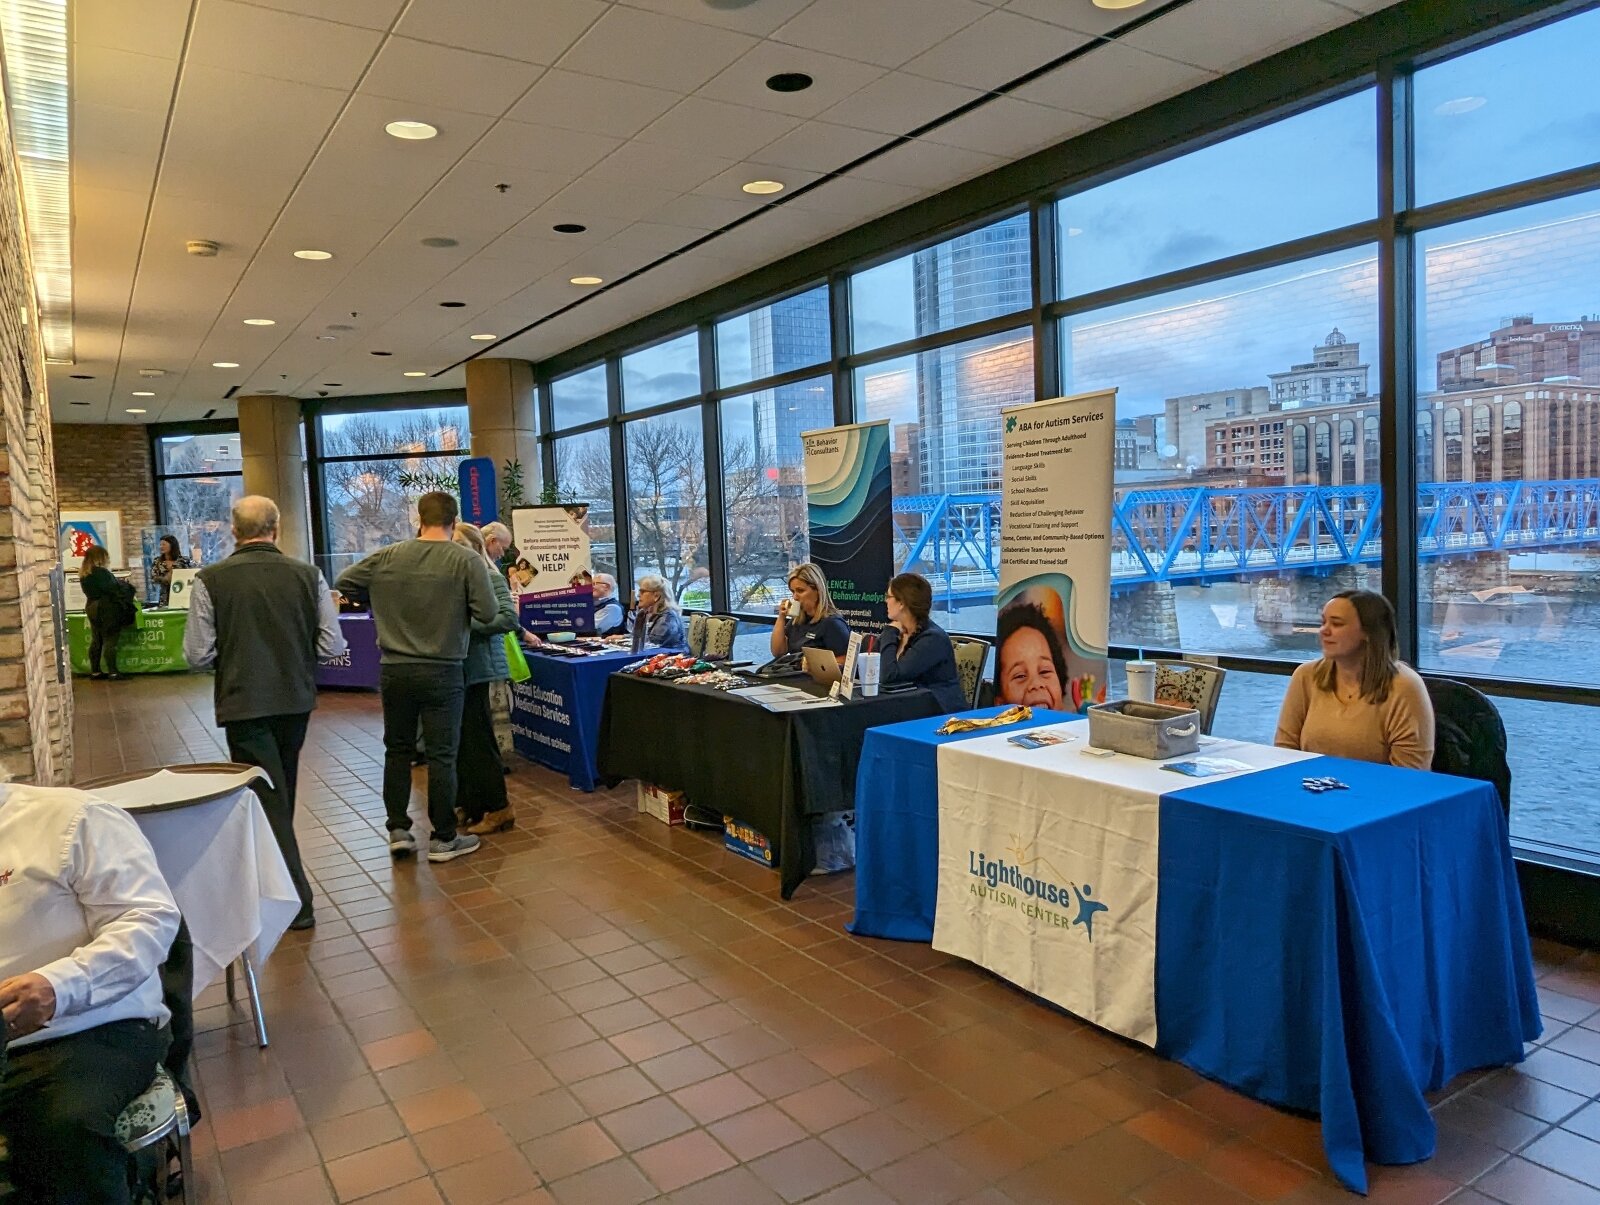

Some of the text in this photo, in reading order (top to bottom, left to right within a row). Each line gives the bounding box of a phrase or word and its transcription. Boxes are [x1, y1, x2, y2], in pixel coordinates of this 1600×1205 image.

[1019, 412, 1104, 432] ABA for Autism Services
[816, 437, 838, 447] Behavior
[1006, 432, 1087, 449] Serving Children Through Adulthood
[811, 446, 839, 456] Consultants
[1005, 451, 1040, 460] Evidence-Based
[1040, 448, 1063, 456] Treatment
[1012, 463, 1033, 471] Language
[1037, 509, 1064, 517] Challenging
[1009, 522, 1032, 530] Vocational
[1032, 522, 1051, 530] Training
[1060, 521, 1079, 529] Support
[1042, 533, 1084, 541] Community-Based
[1084, 532, 1105, 540] Options
[1043, 546, 1066, 554] Approach
[537, 552, 570, 562] WE CAN
[542, 563, 566, 572] HELP!
[826, 580, 855, 590] LENCE in
[832, 590, 861, 601] Behavior
[533, 685, 563, 707] Education
[514, 695, 570, 726] Mediation Services
[969, 849, 1070, 909] Lighthouse
[970, 882, 1071, 931] AUTISM CENTER
